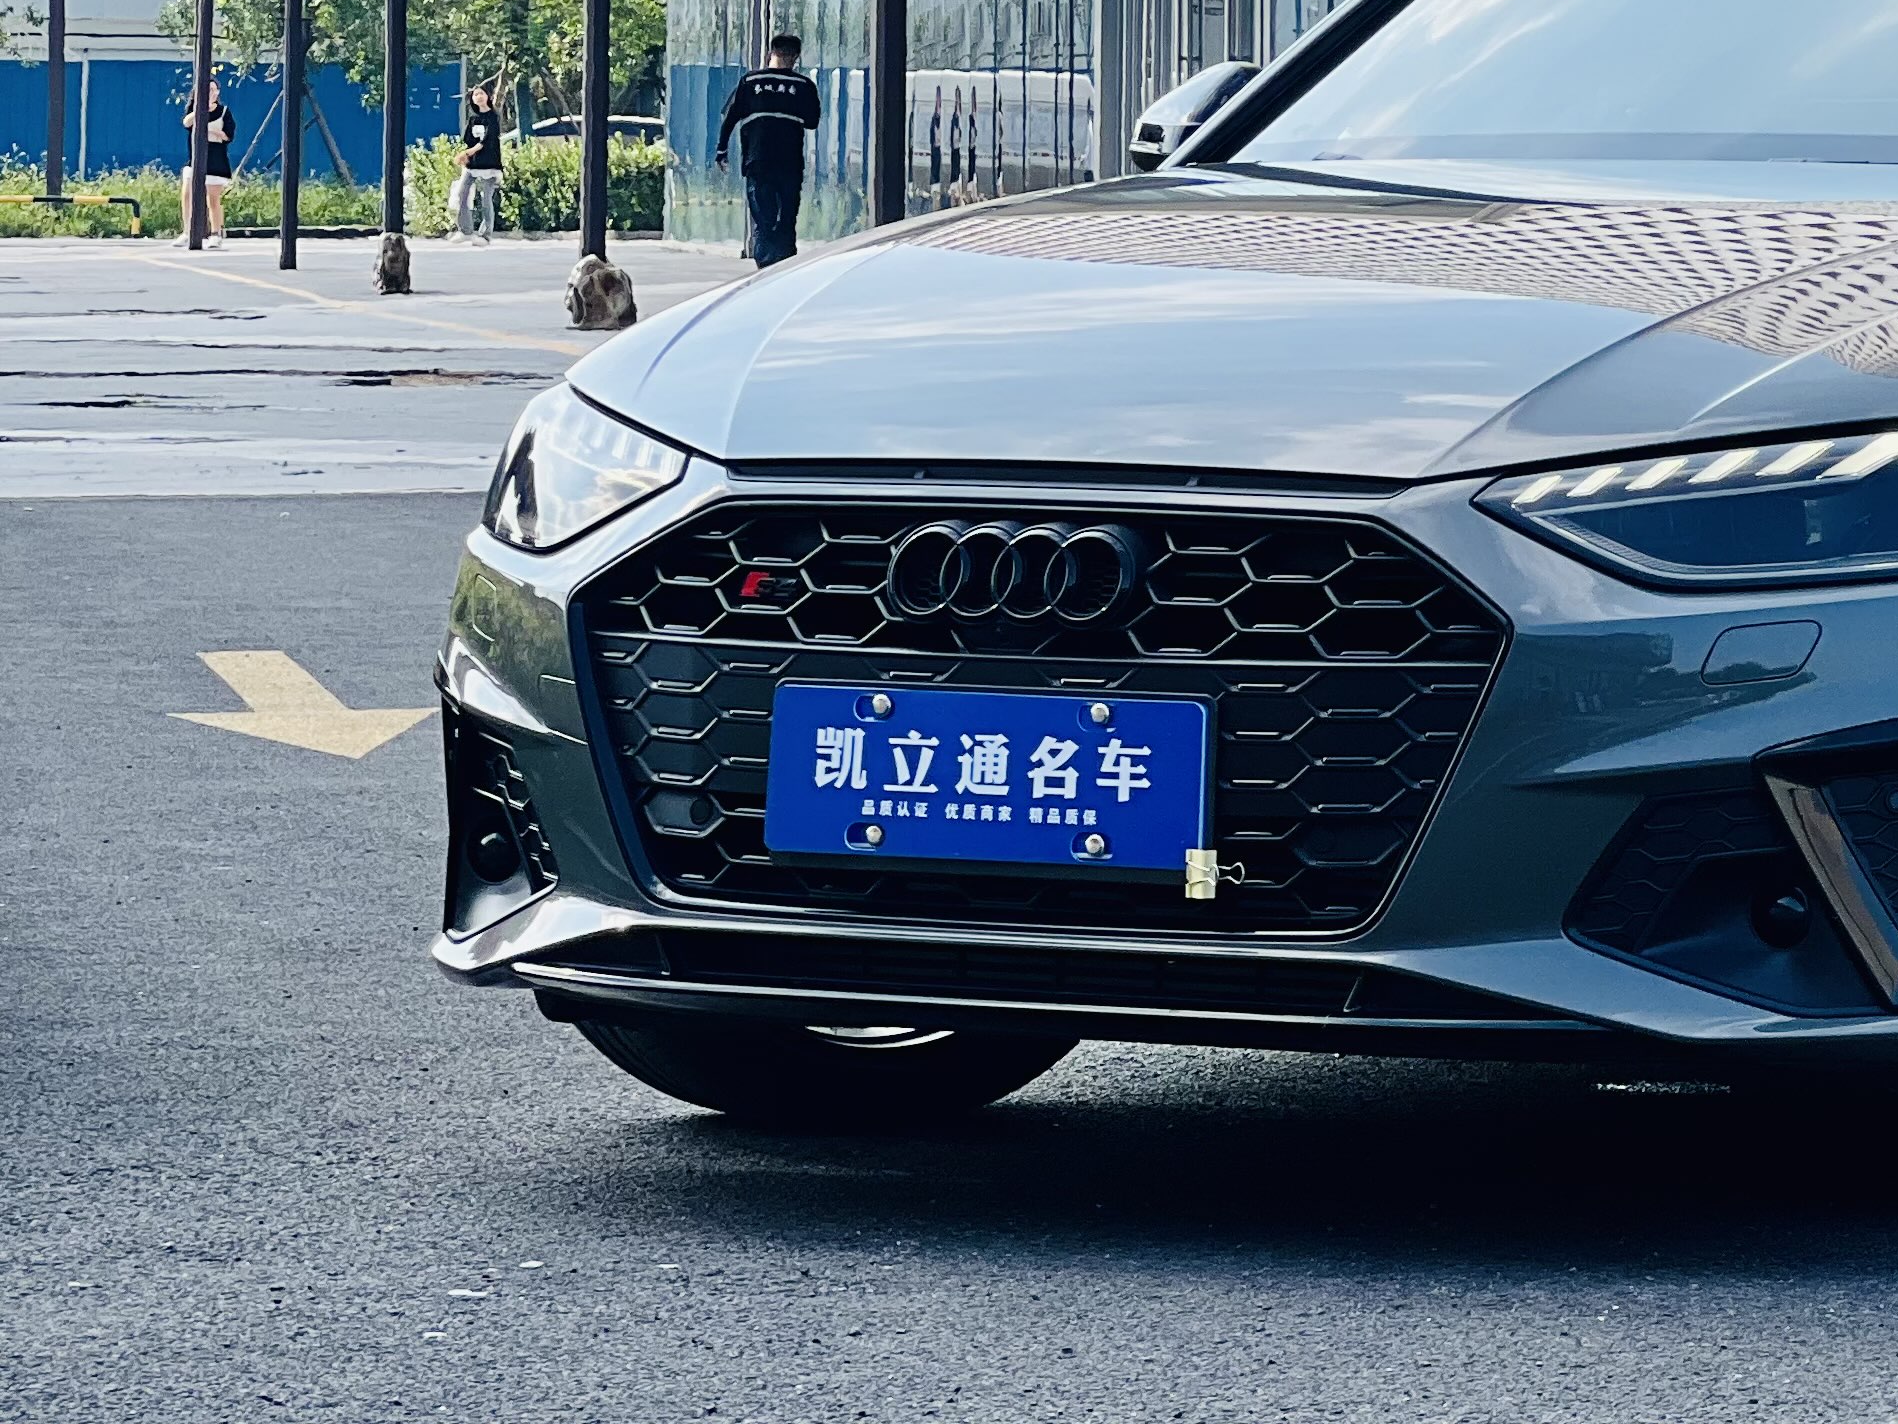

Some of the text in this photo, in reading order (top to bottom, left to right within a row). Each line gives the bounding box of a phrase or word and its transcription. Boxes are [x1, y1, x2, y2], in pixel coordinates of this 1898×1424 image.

[813, 726, 1153, 804] 凯立通名车
[861, 799, 1097, 826] 品质认证 优质商家 精品质保
